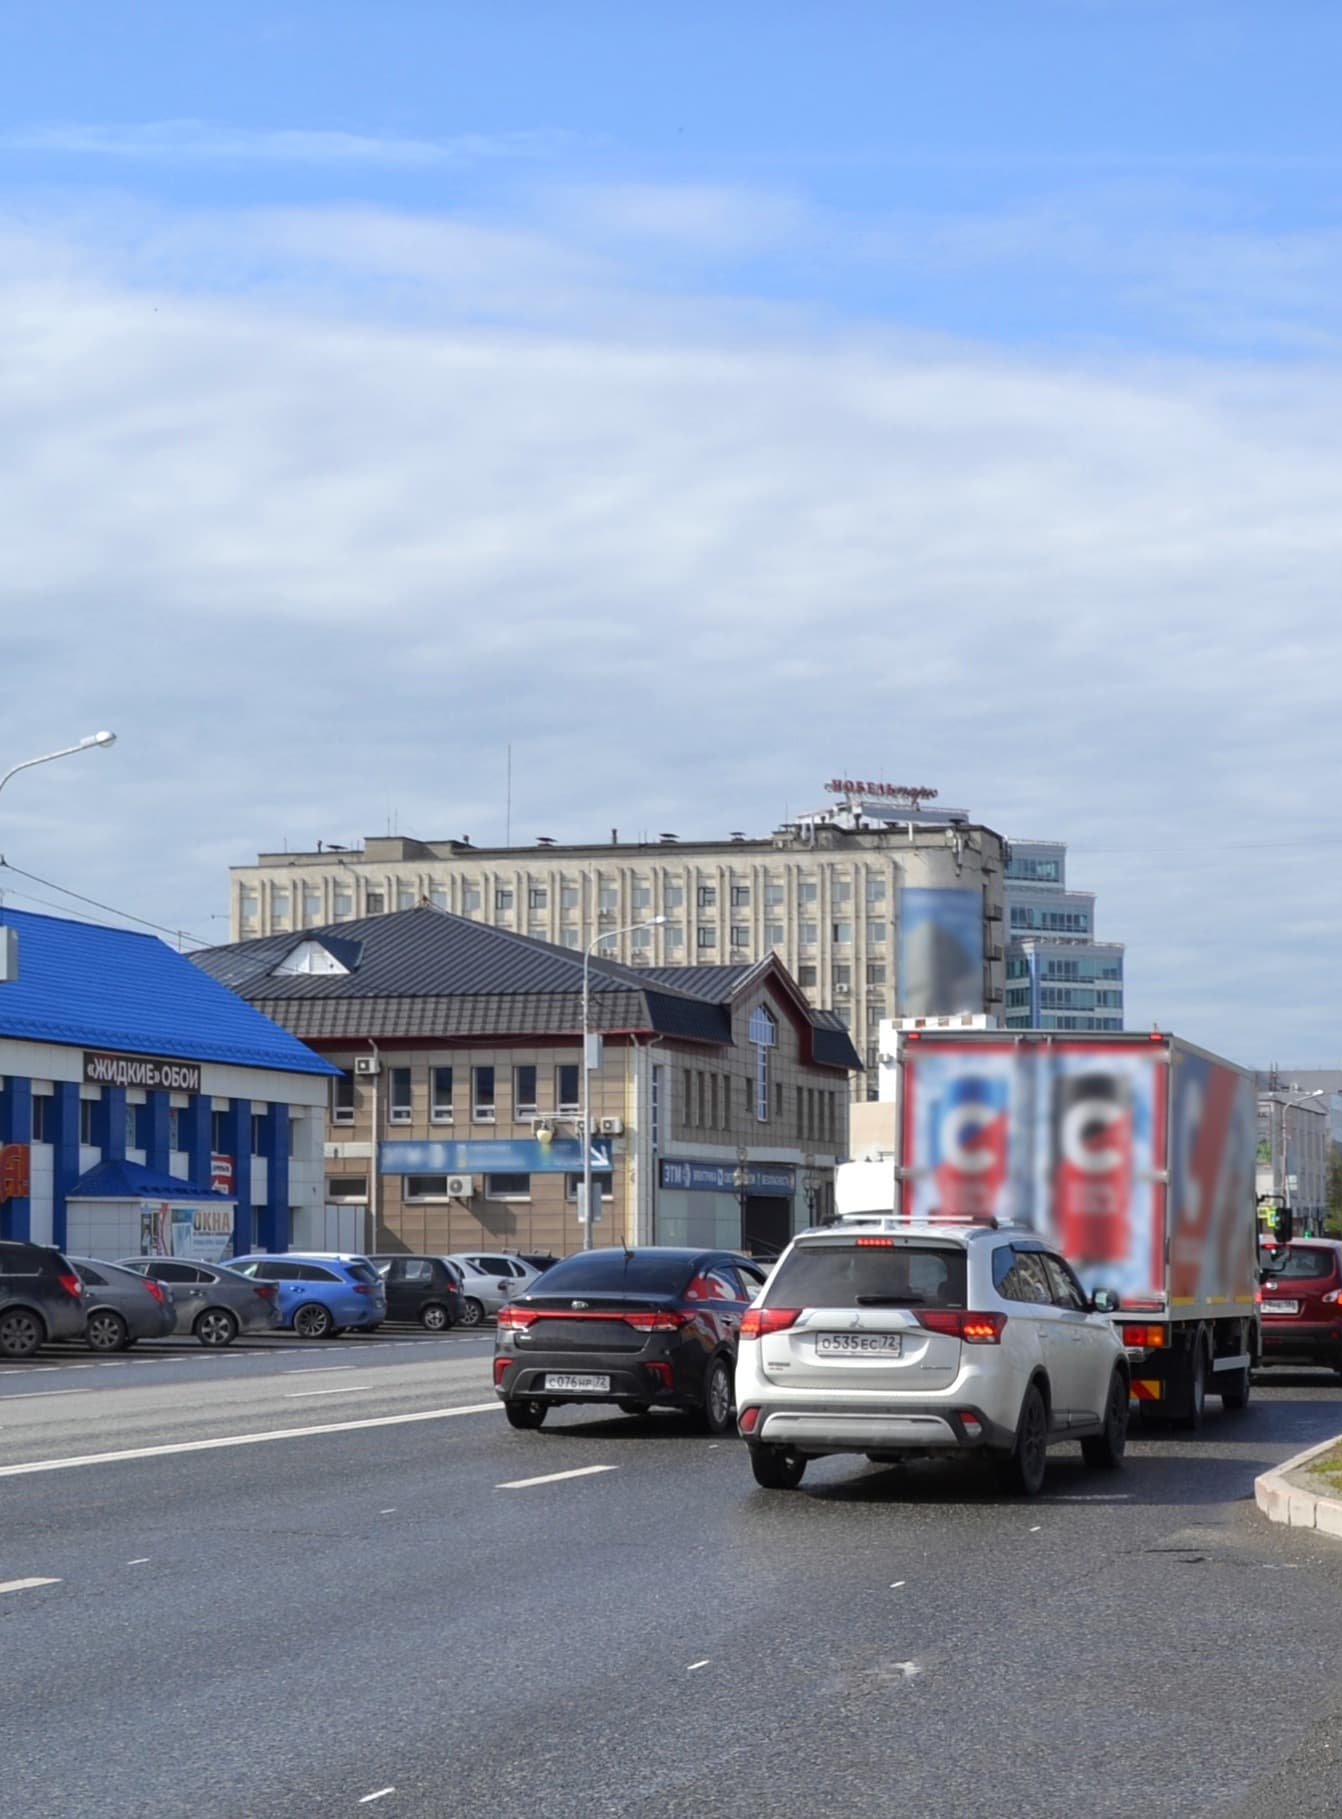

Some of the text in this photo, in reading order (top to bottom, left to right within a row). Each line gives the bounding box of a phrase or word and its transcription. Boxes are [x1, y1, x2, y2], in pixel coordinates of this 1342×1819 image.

[87, 1058, 199, 1089] «ЖИДКИЕ» ОБОИ
[194, 1212, 231, 1232] ОКНА
